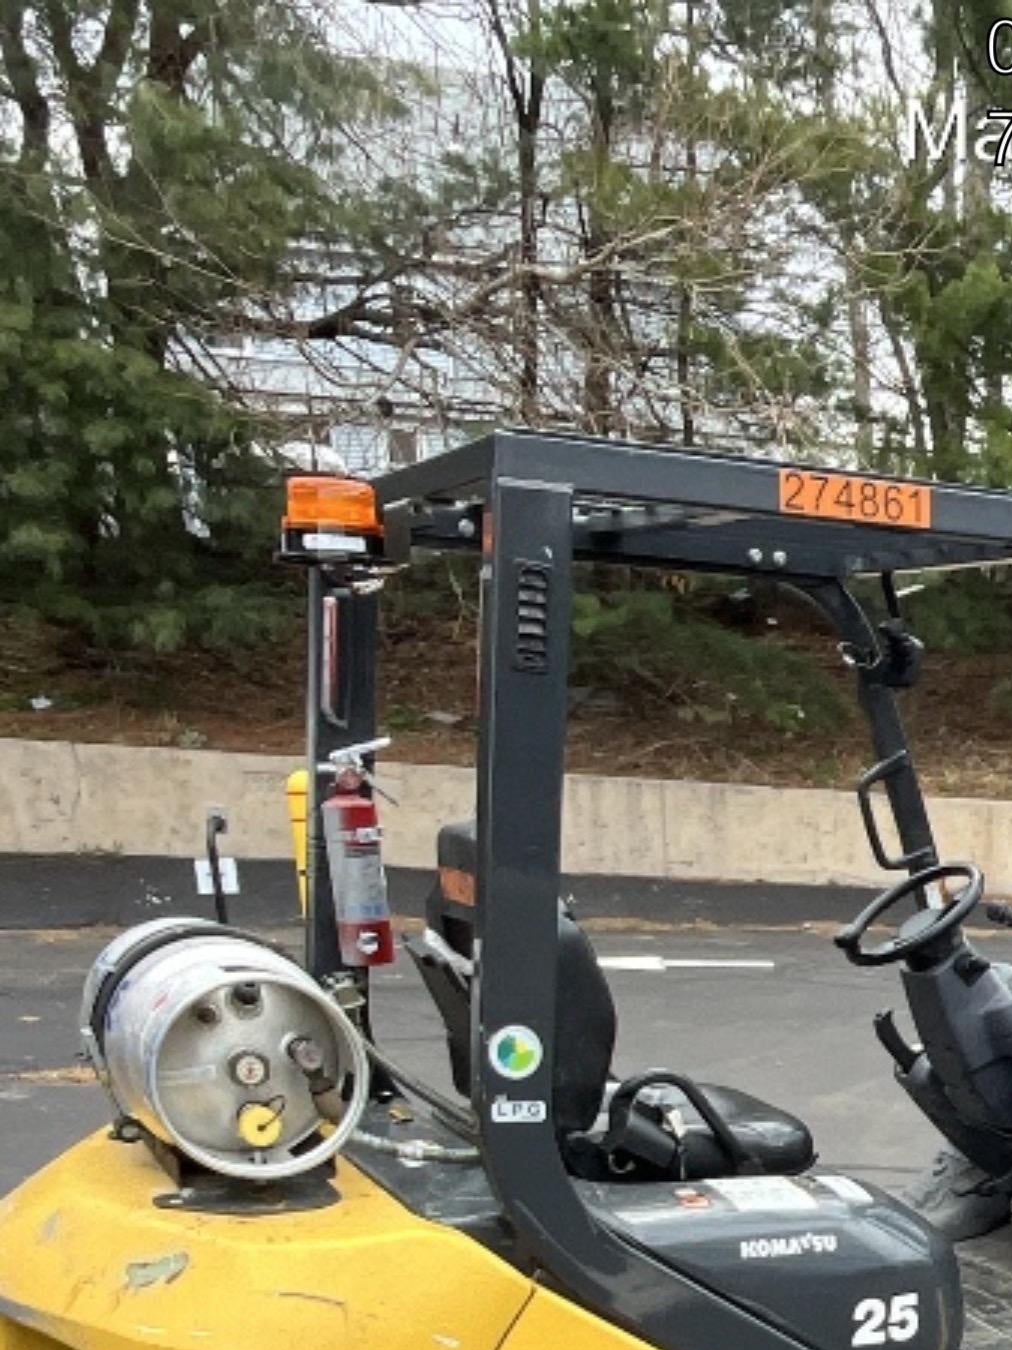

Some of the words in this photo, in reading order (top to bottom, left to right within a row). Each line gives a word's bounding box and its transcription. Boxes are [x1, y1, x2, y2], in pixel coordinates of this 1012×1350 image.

[784, 472, 923, 523] 274861
[739, 1231, 839, 1259] KOMATSU
[851, 1292, 919, 1348] 25
